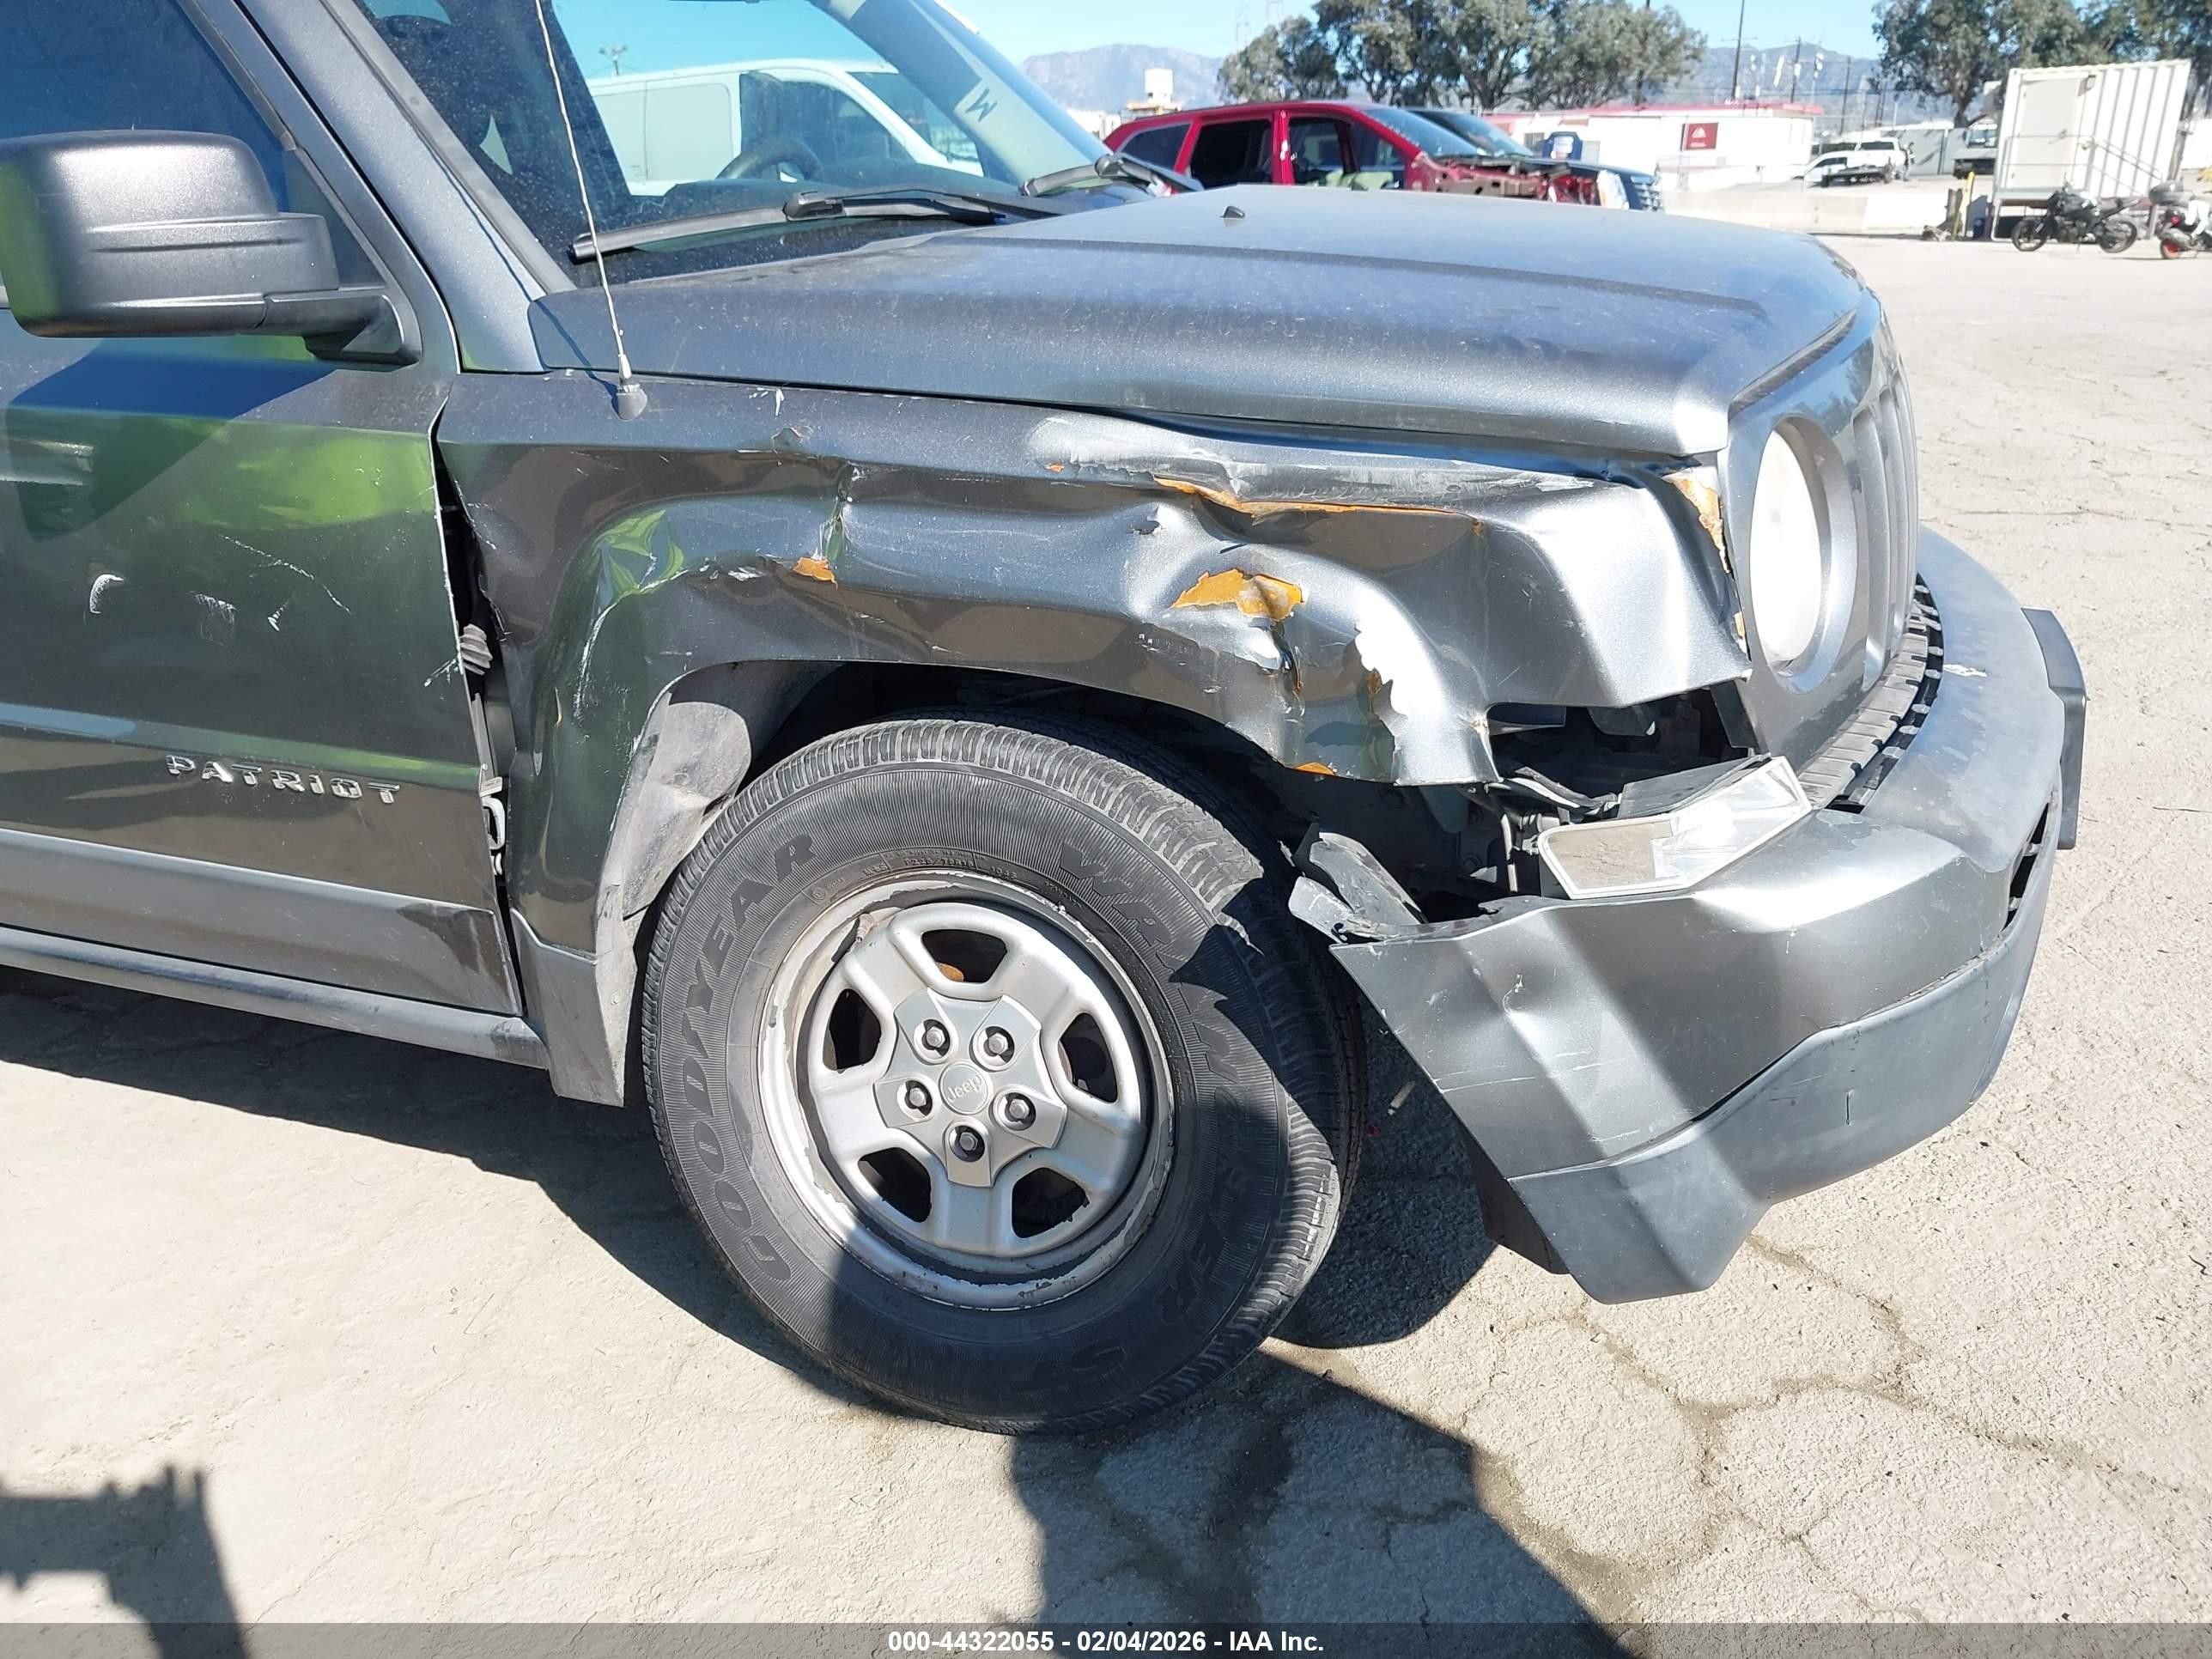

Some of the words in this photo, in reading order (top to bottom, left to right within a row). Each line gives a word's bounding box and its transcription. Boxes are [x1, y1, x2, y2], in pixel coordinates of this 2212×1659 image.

[166, 754, 401, 805] PATRIOT
[681, 833, 816, 1281] GOODYEAR
[946, 1074, 982, 1103] Jeep
